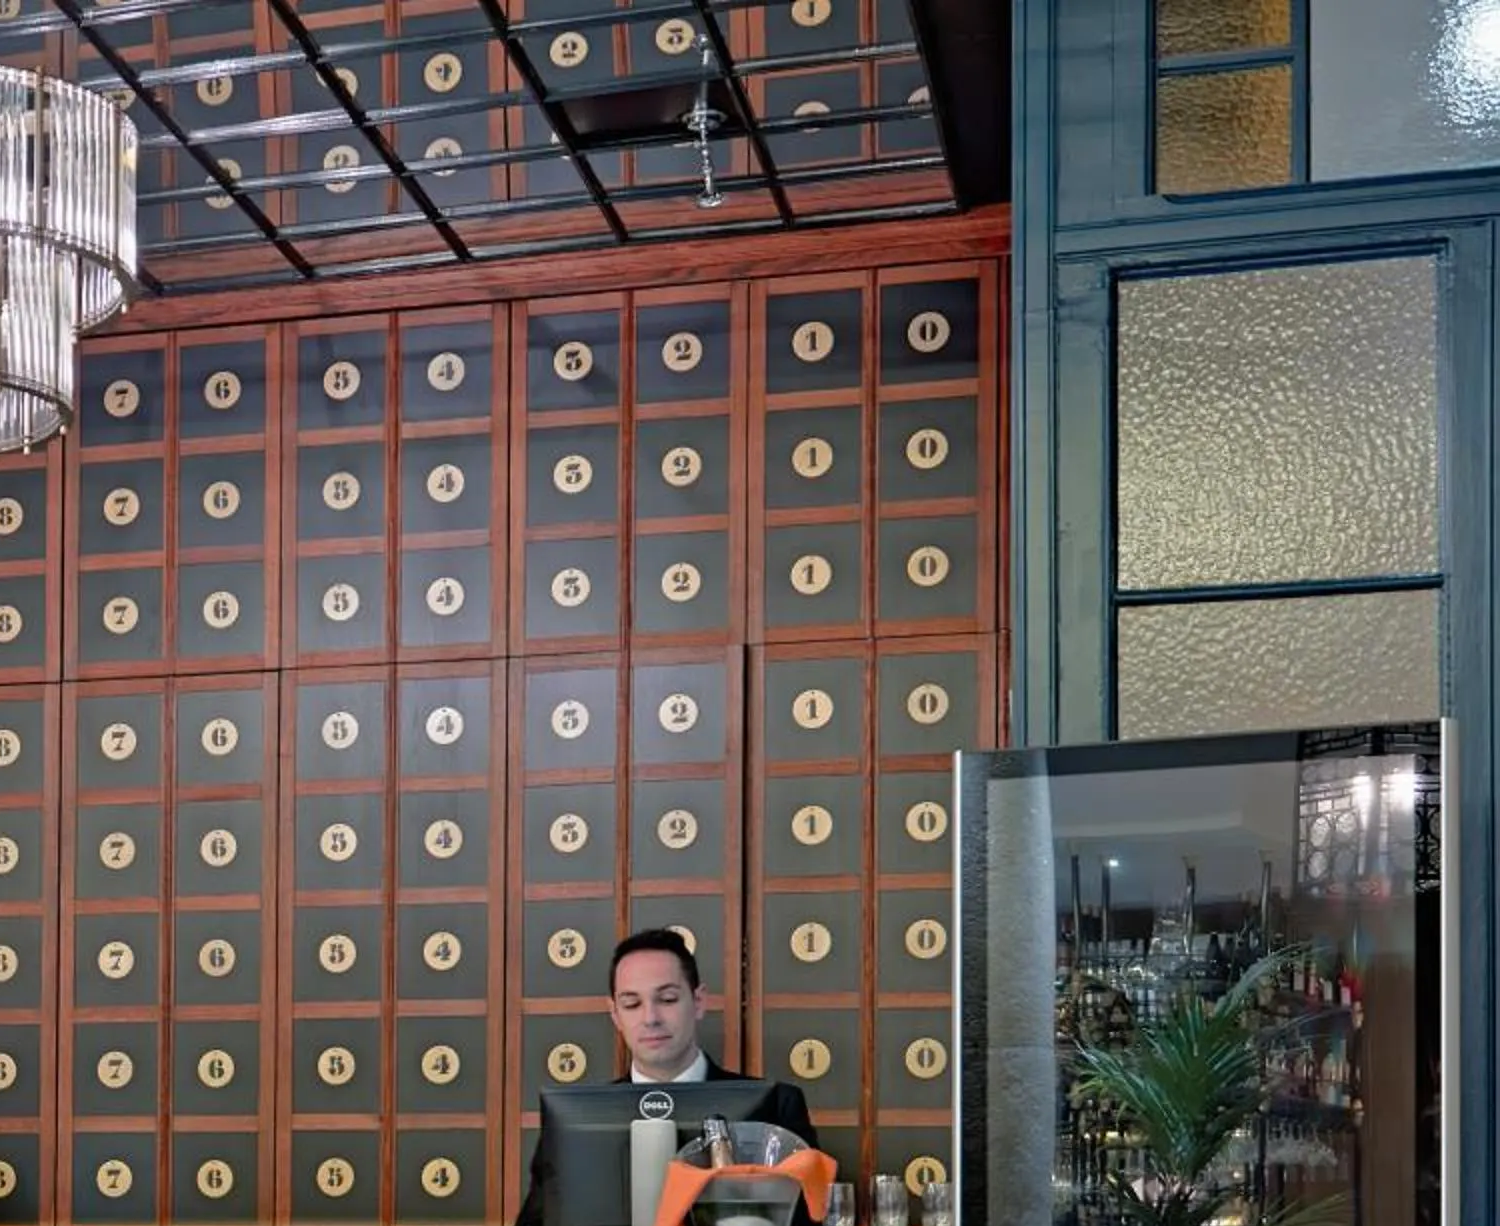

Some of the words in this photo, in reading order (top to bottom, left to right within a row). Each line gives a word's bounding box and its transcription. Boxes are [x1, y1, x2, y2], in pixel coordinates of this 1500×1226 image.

[919, 321, 939, 342] 0
[673, 339, 693, 361] 2
[437, 360, 456, 382] 4
[114, 387, 129, 409] 7
[214, 379, 231, 400] 6
[918, 437, 938, 459] 0
[672, 455, 691, 477] 2
[437, 471, 456, 493] 4
[113, 495, 129, 517] 7
[212, 489, 229, 510] 6
[918, 555, 938, 577] 0
[671, 571, 691, 593] 2
[435, 585, 455, 607] 4
[112, 604, 129, 625] 7
[213, 599, 230, 620] 6
[670, 702, 689, 724] 2
[918, 692, 939, 714] 0
[435, 714, 455, 736] 4
[111, 731, 127, 752] 7
[211, 727, 228, 747] 6
[669, 818, 687, 840] 2
[917, 811, 937, 833] 0
[210, 837, 227, 859] 6
[434, 827, 453, 850] 4
[109, 840, 125, 862] 7
[916, 927, 937, 951] 0
[109, 949, 125, 971] 7
[208, 947, 226, 968] 6
[432, 940, 452, 962] 4
[208, 1059, 225, 1079] 6
[431, 1053, 450, 1075] 4
[916, 1047, 937, 1069] 0
[107, 1059, 124, 1080] 7
[106, 1168, 122, 1189] 7
[205, 1169, 223, 1189] 6
[431, 1167, 450, 1189] 4
[916, 1167, 936, 1186] 0
